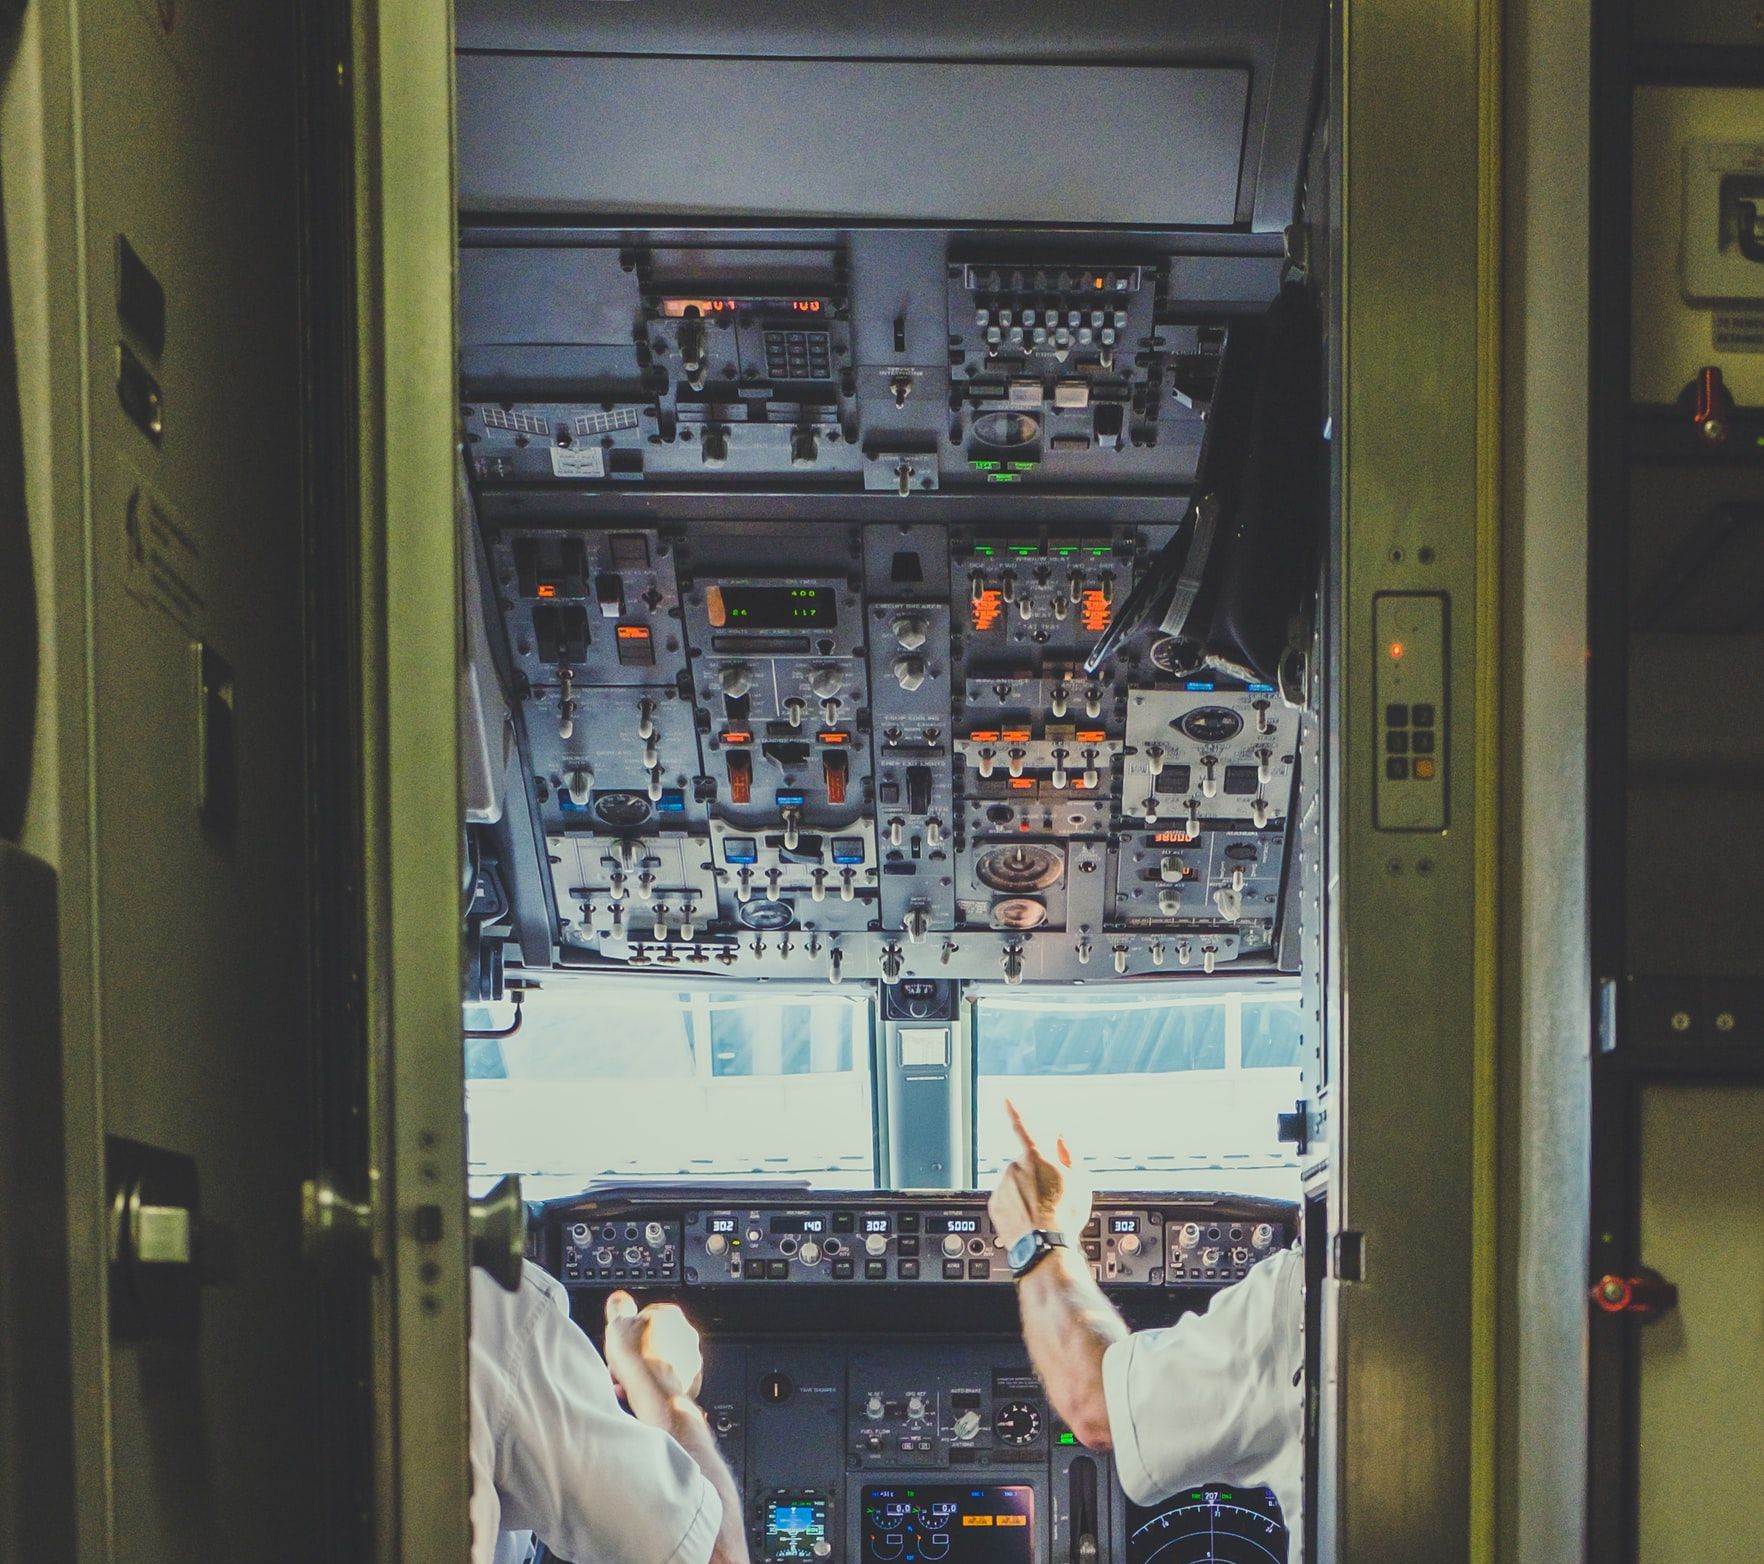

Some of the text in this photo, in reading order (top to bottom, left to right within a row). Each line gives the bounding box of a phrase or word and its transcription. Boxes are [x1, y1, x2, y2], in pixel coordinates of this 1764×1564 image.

[713, 1220, 734, 1231] 302
[804, 1220, 822, 1231] 140
[866, 1220, 887, 1231] 302
[948, 1220, 976, 1231] 5000
[1115, 1221, 1135, 1231] 302
